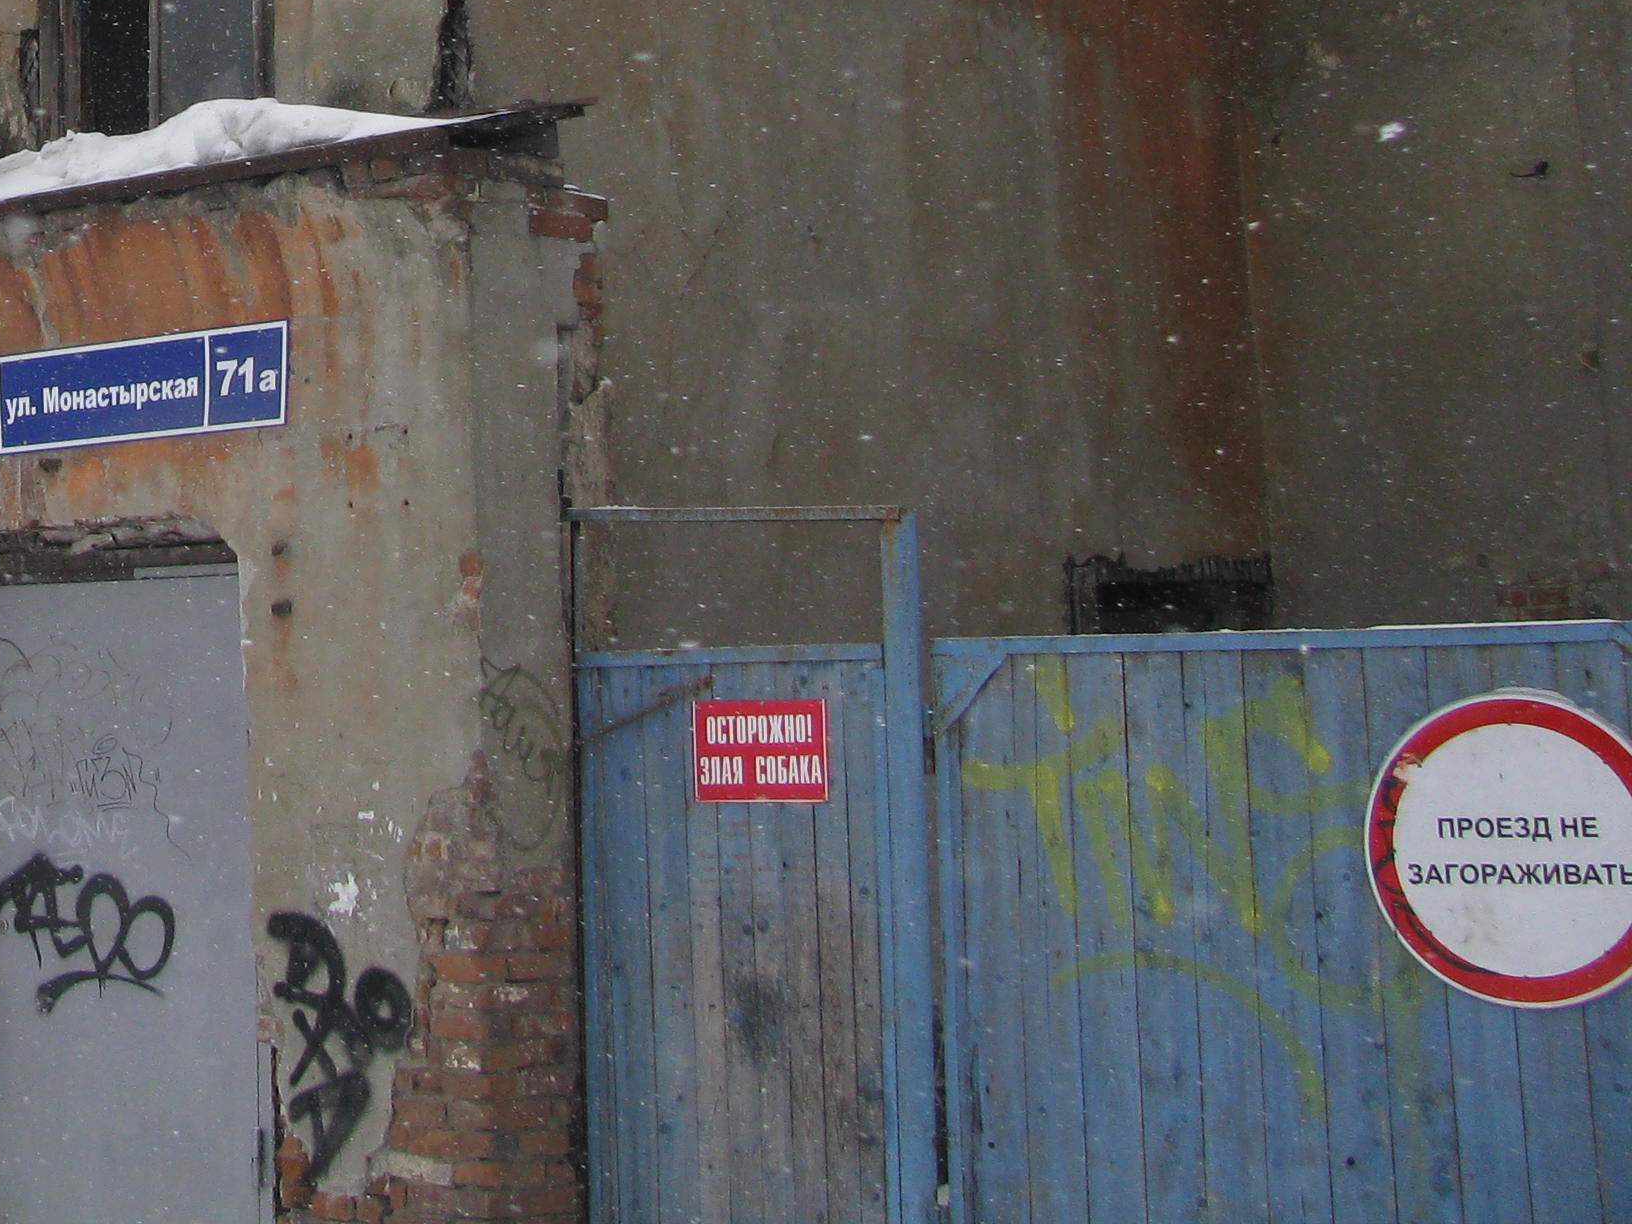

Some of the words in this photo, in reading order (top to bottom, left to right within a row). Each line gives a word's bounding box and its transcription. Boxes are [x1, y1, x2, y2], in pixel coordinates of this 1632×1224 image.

[5, 395, 37, 424] ул.
[42, 375, 199, 414] Монастырская
[216, 356, 277, 397] 71а
[705, 714, 813, 745] ОСТОРОЖНО!
[699, 756, 744, 785] ЗЛАЯ
[755, 754, 823, 785] СОБАКА
[1437, 817, 1552, 842] ПРОЕЗД
[1560, 816, 1599, 838] НЕ
[1408, 863, 1632, 885] ЗАГОРАЖИВАТЬ
